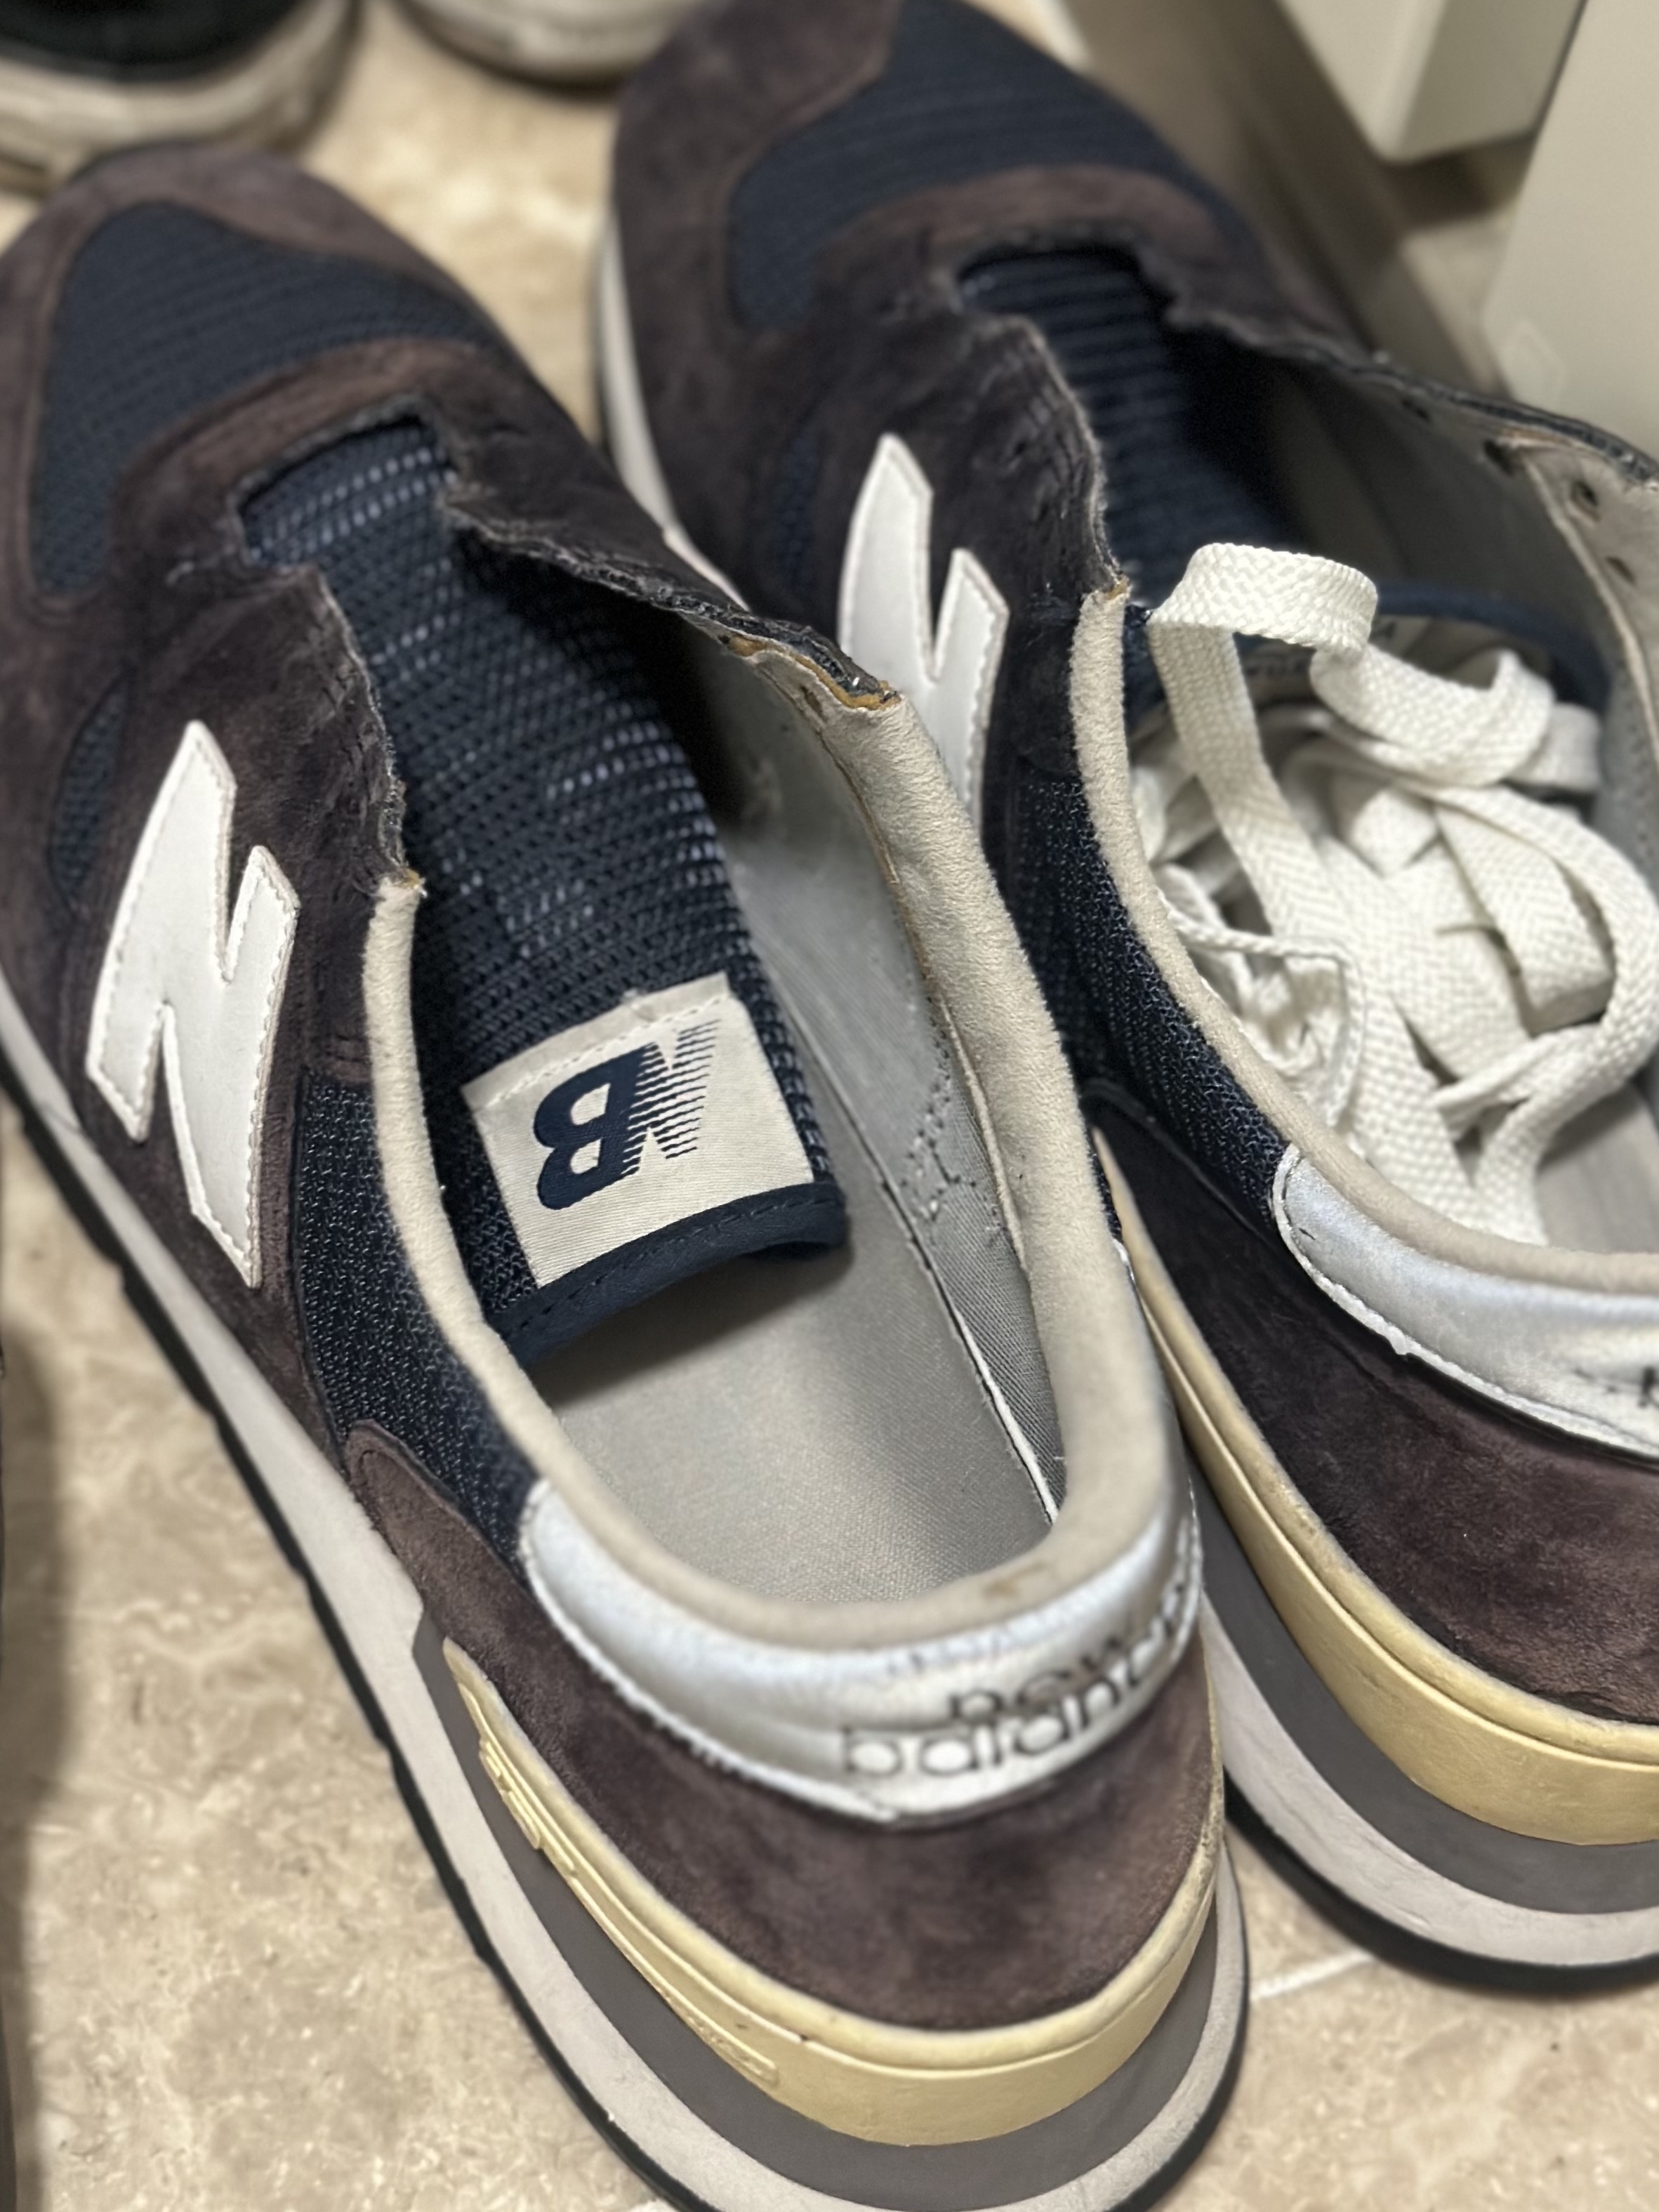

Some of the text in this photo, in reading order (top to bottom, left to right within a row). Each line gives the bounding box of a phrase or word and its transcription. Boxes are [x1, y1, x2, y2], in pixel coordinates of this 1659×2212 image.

[86, 719, 302, 1289] N
[533, 1018, 720, 1211] NB
[841, 1580, 1187, 1779] balanc
